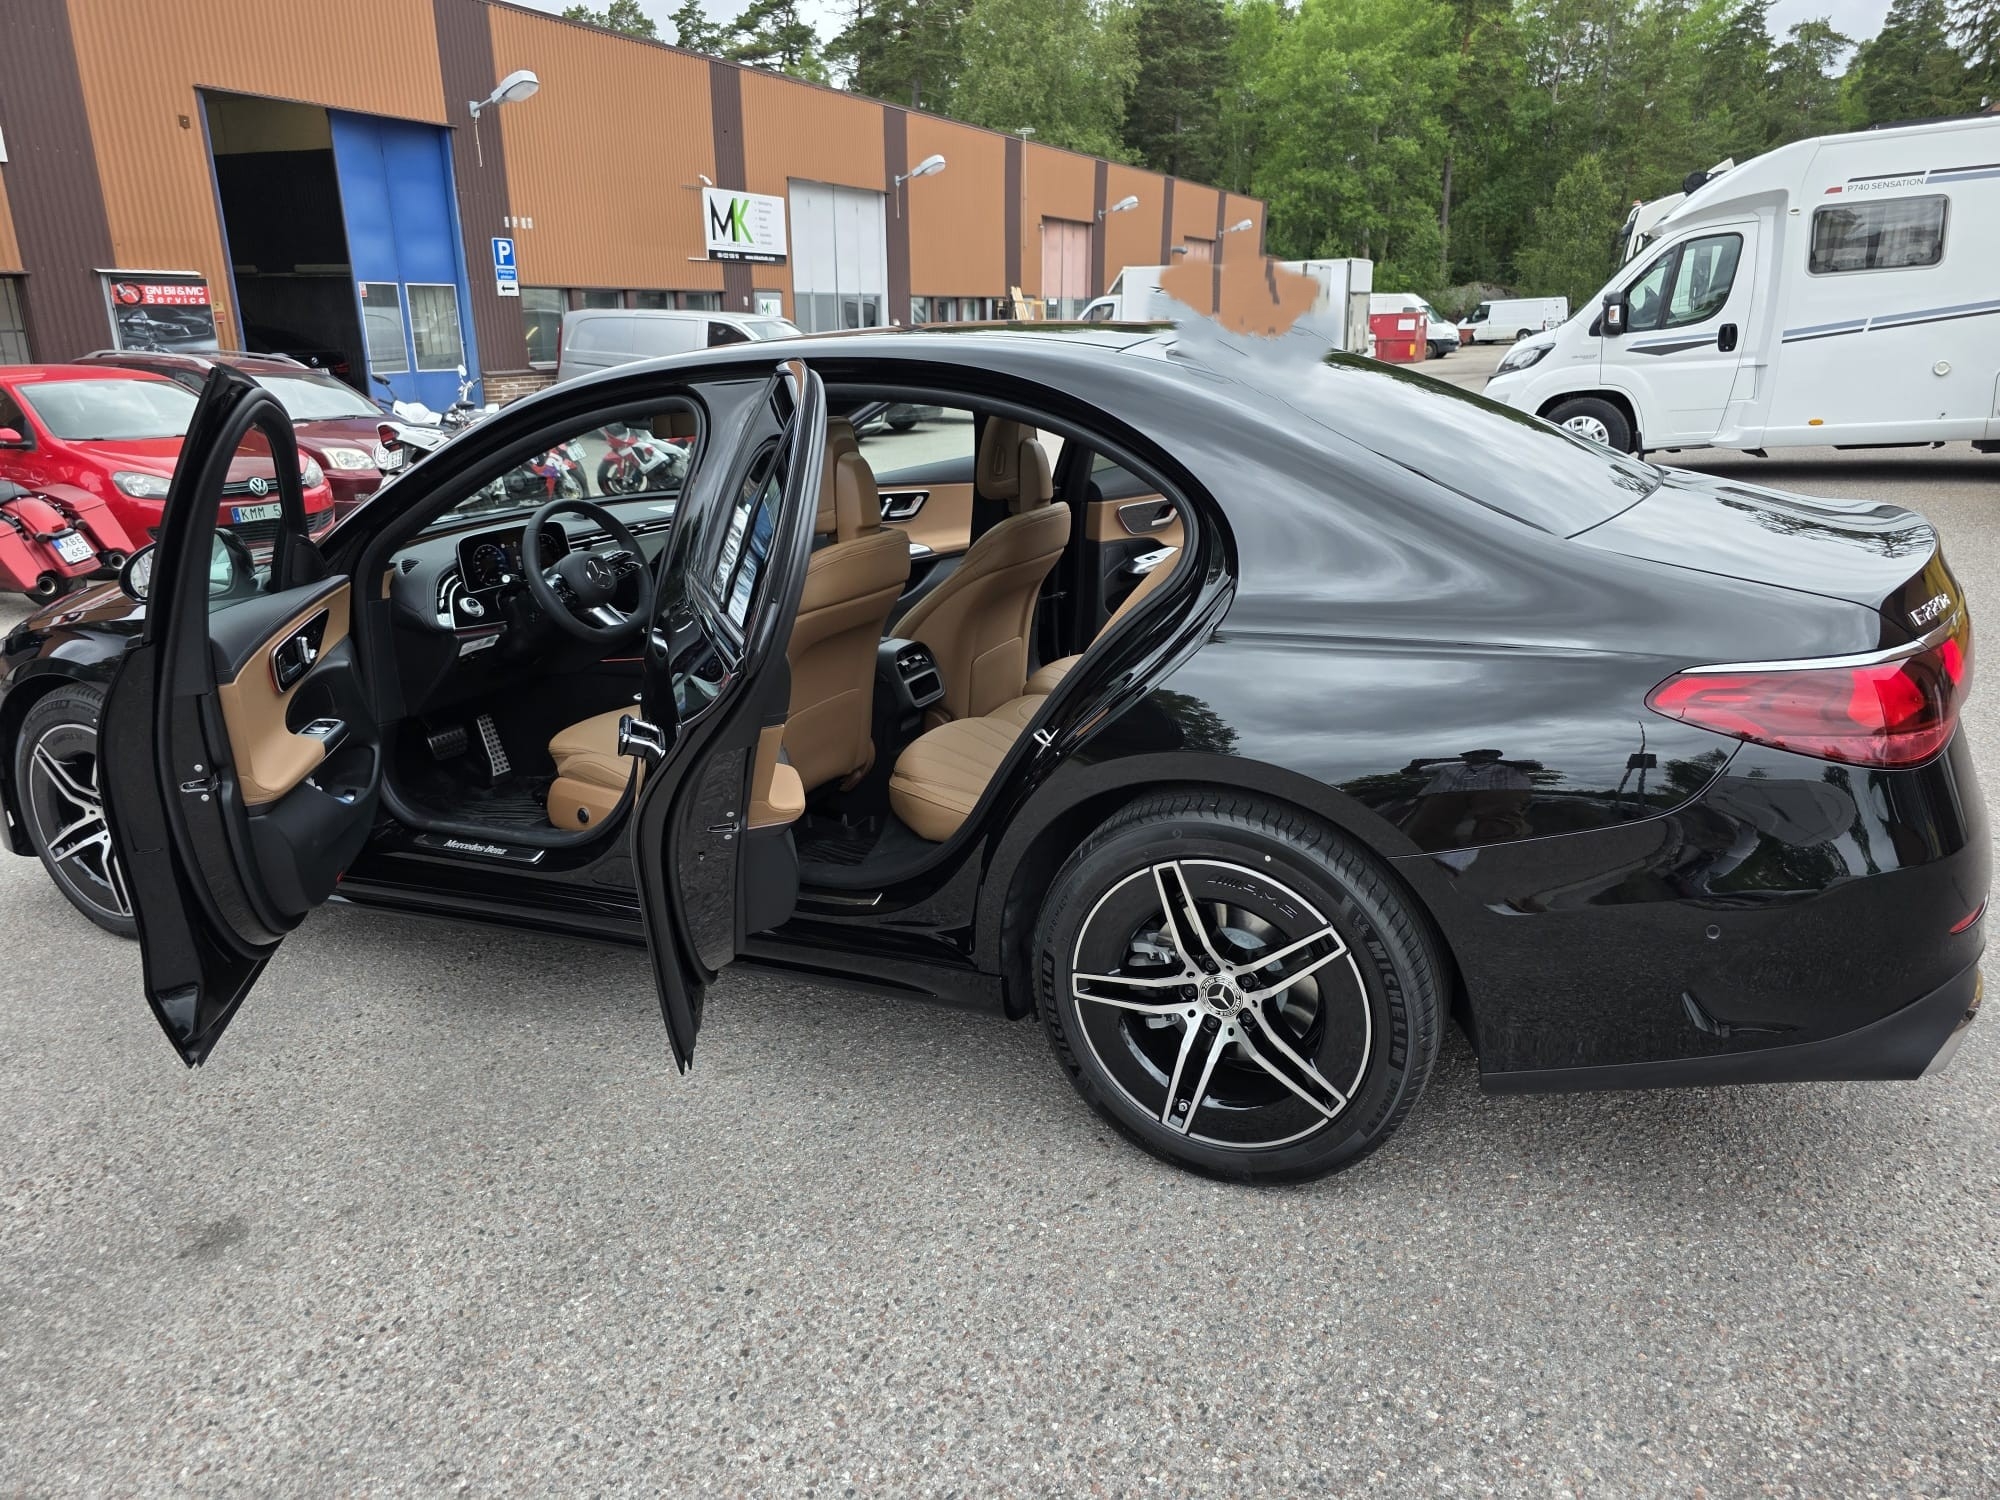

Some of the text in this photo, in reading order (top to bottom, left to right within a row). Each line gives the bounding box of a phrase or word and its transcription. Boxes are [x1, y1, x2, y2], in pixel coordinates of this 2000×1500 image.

[1847, 178, 1925, 193] P740 SENSATION
[709, 194, 754, 244] MK
[497, 241, 511, 264] P
[145, 286, 162, 295] GN
[186, 287, 204, 296] MC
[146, 294, 206, 304] Service
[240, 506, 266, 521] KMM
[62, 535, 84, 548] XBE
[71, 545, 91, 557] 652
[443, 839, 508, 855] Mercedes-Benz
[1367, 939, 1408, 1066] MICHELIN
